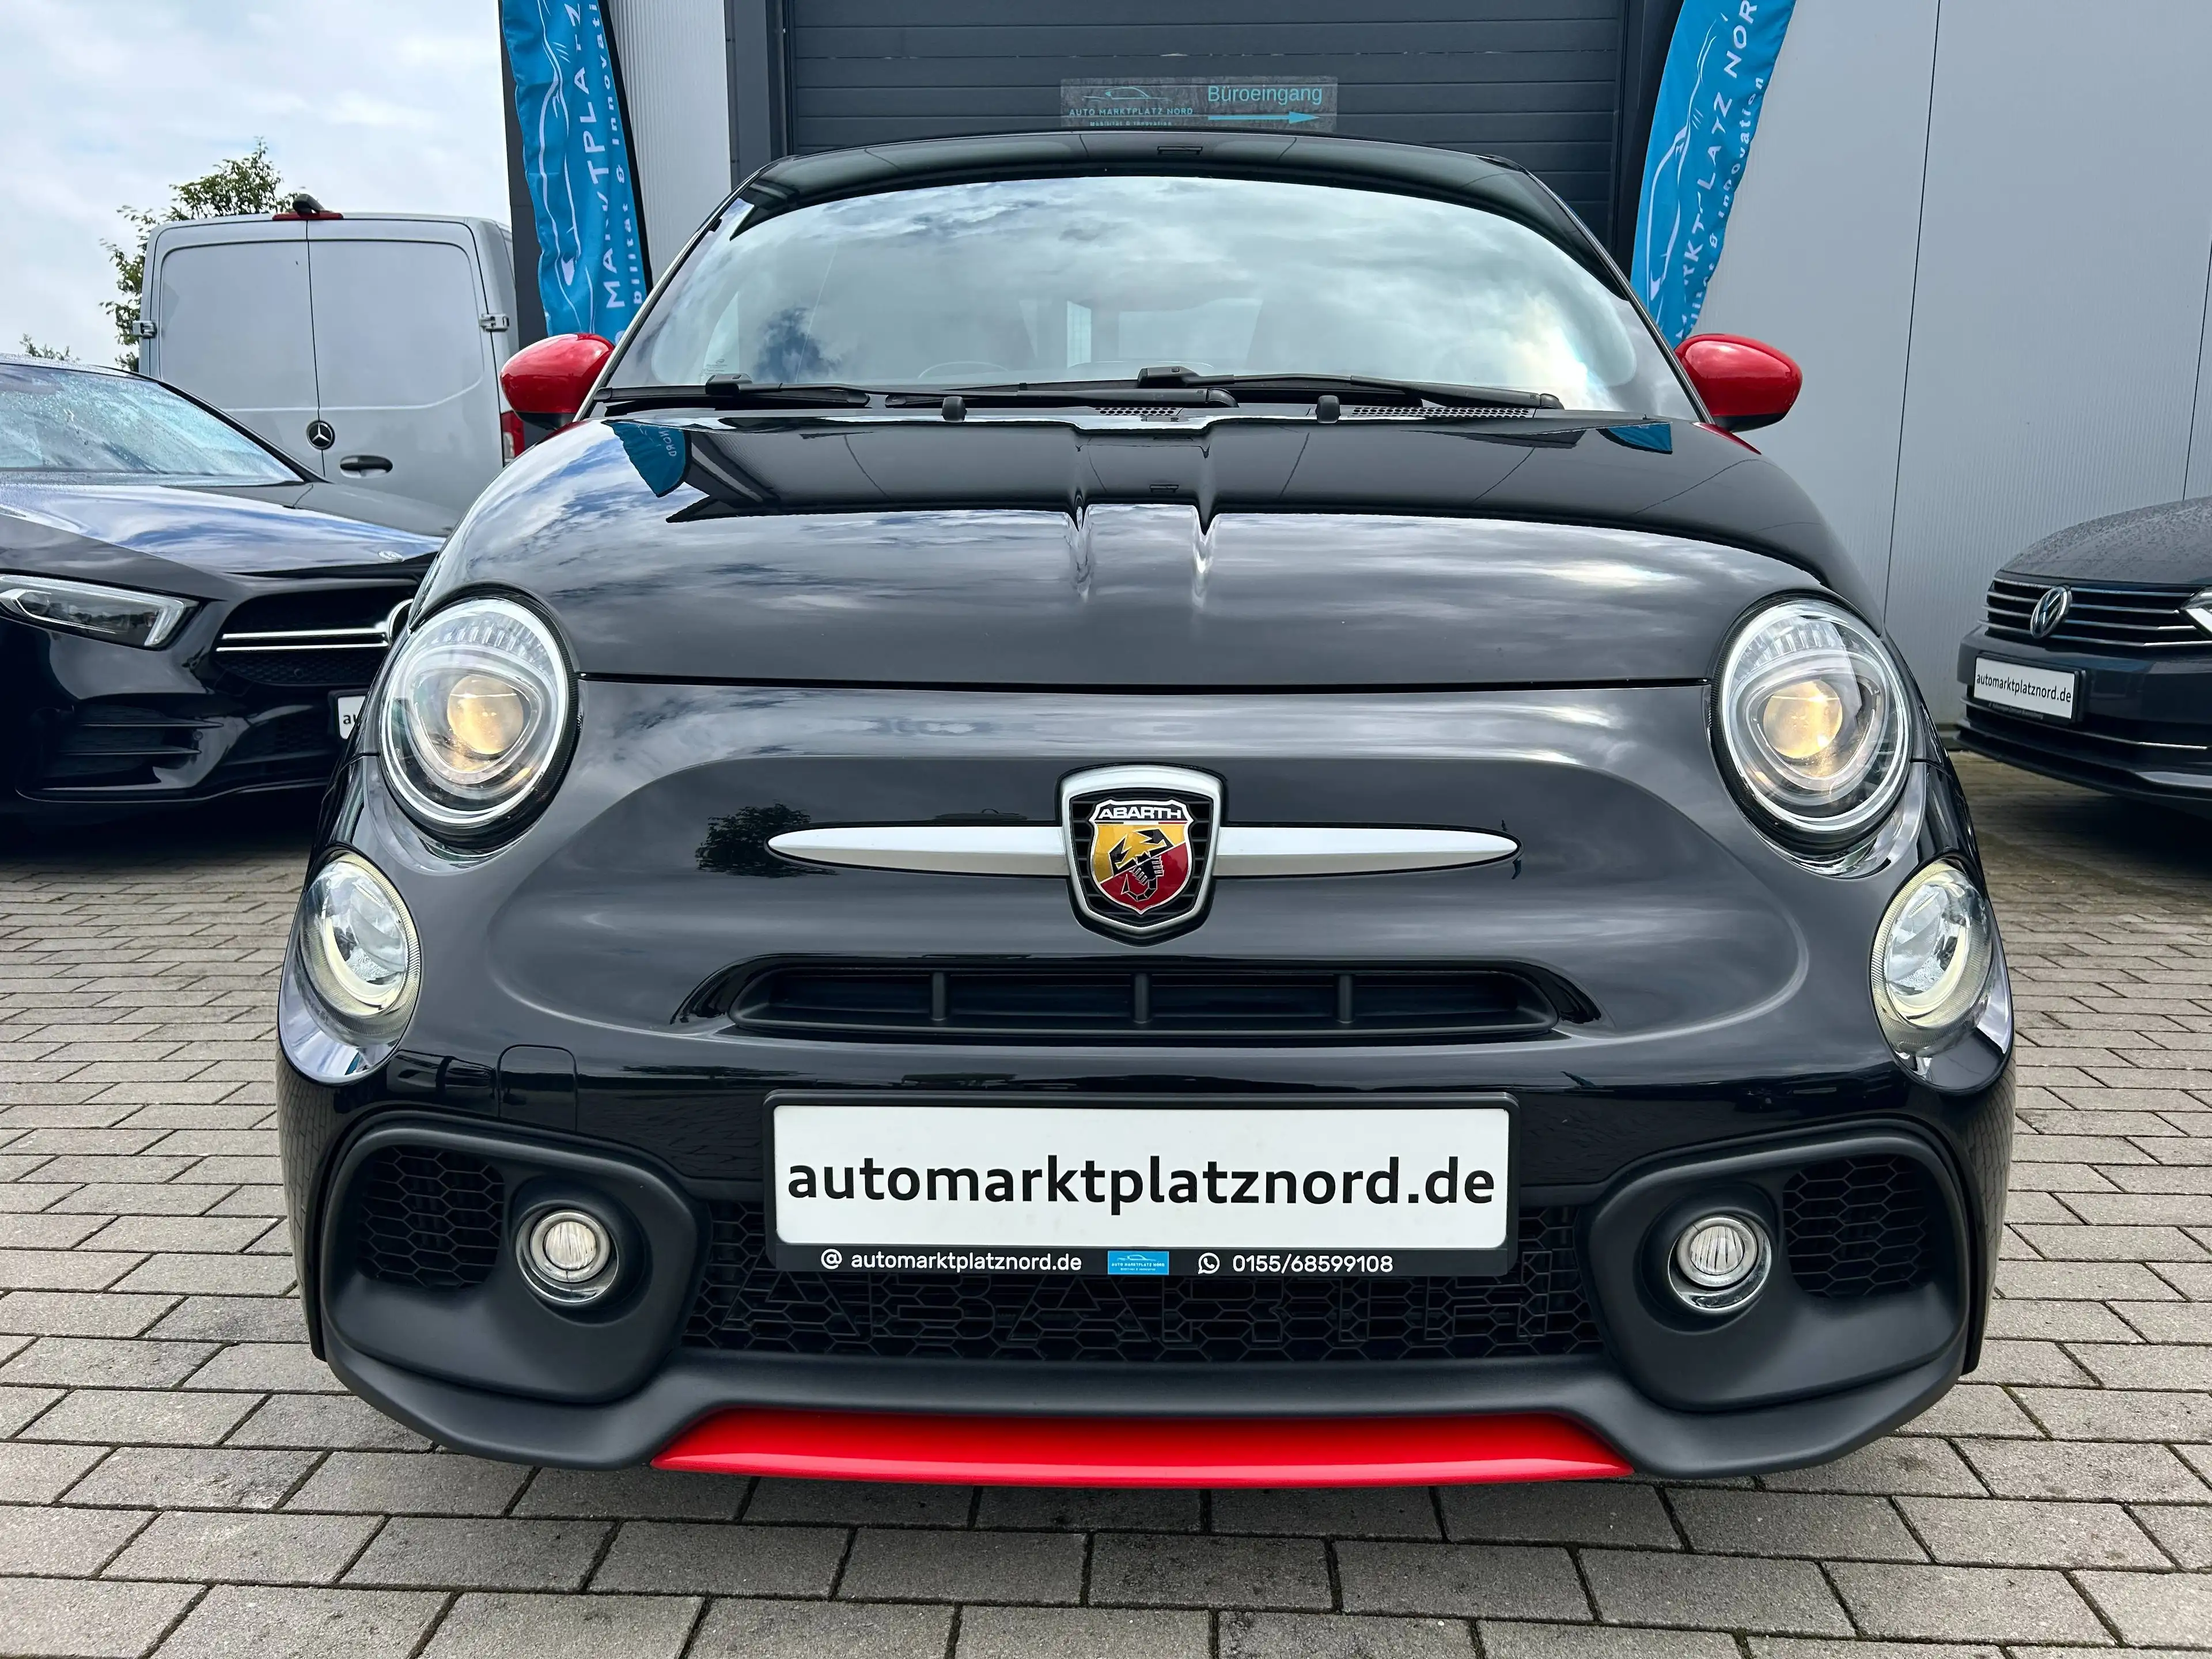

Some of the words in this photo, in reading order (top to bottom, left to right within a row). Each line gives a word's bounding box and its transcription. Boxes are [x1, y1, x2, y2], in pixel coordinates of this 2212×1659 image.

[1724, 0, 1758, 78] NOR
[589, 3, 619, 145] Innovati
[1208, 85, 1323, 105] Büroeingang
[1099, 108, 1163, 116] MARKTPLATZ
[1976, 673, 2072, 703] automarktplatznord.de
[1099, 806, 1181, 819] ABARTH
[789, 1155, 1495, 1216] automarktplatznord.de
[851, 1252, 1082, 1272] automarktplatznord.de
[1232, 1253, 1393, 1274] 0155/68599108
